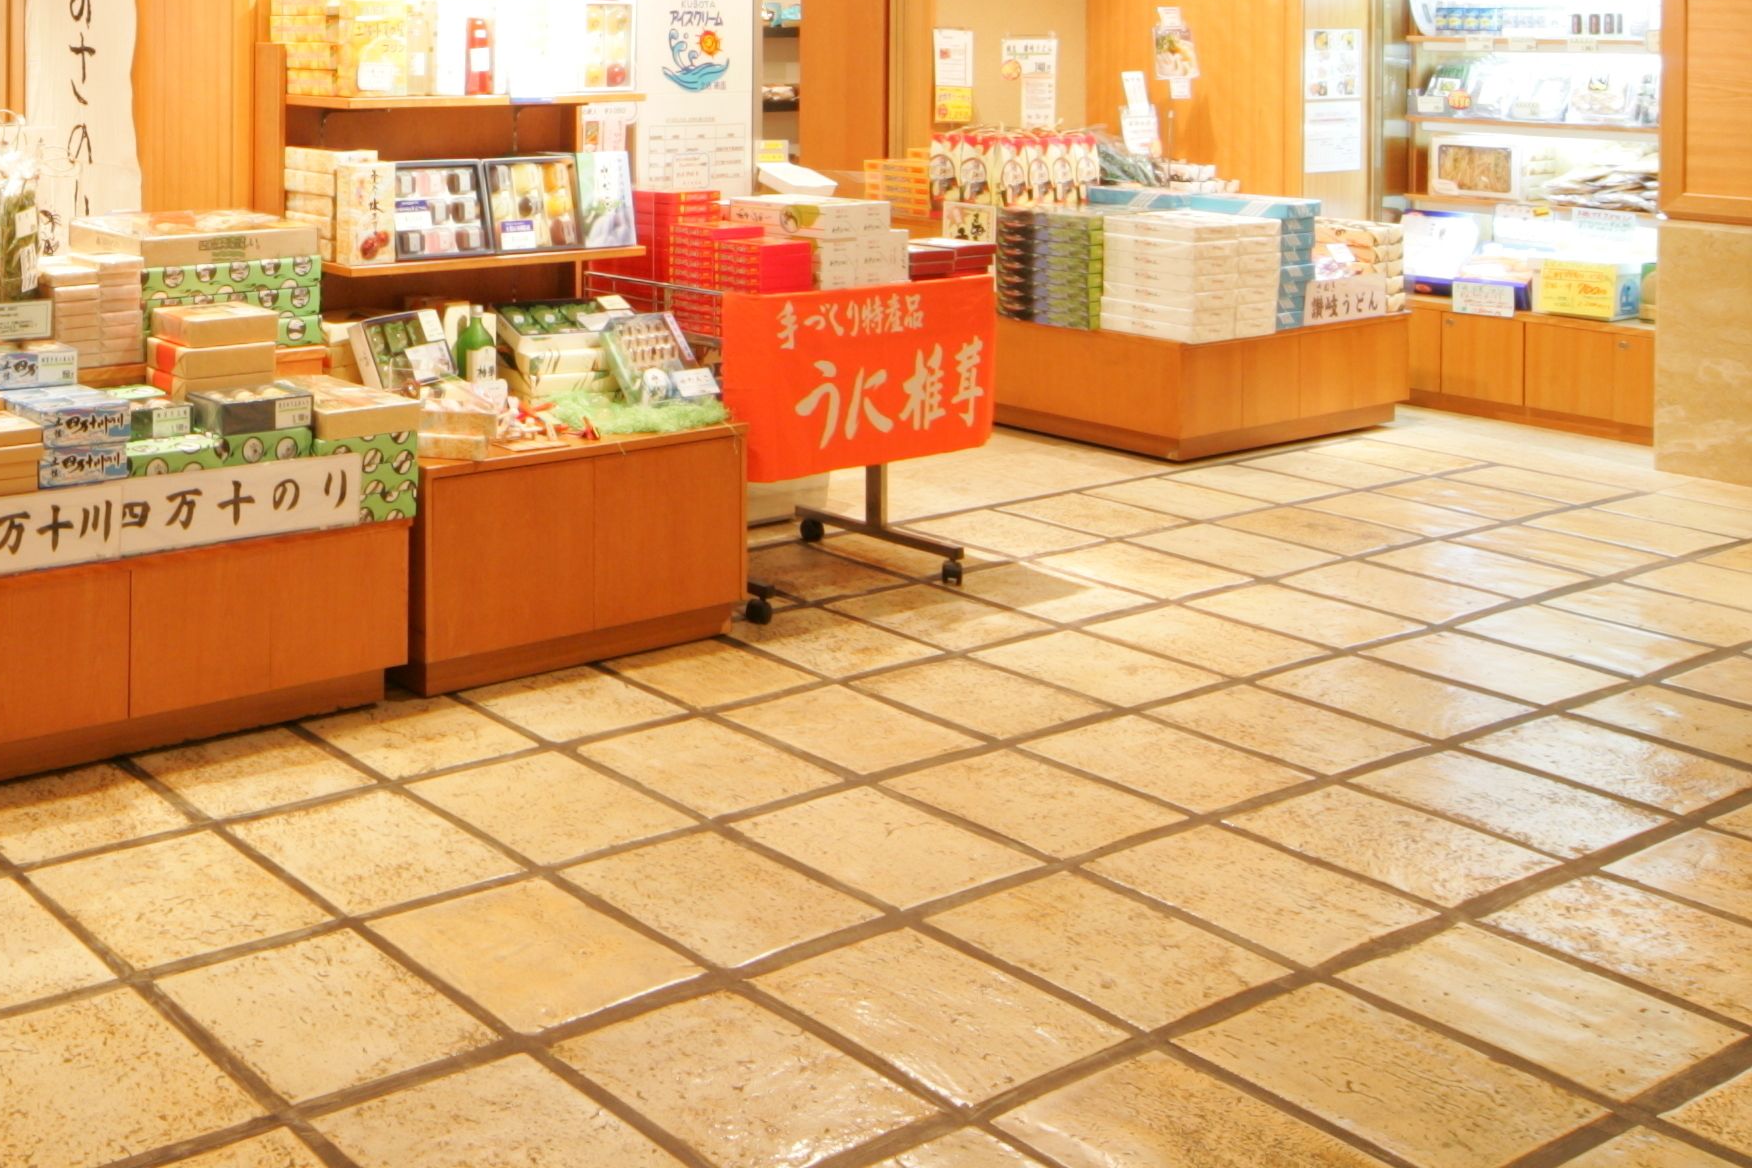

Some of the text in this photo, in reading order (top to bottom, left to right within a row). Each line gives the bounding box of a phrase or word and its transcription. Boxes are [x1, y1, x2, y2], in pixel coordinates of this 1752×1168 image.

[669, 10, 724, 27] アイスクリーム
[776, 293, 924, 350] 手づくり特産品
[795, 335, 985, 450] うに椎茸
[120, 469, 348, 528] 四万十のり
